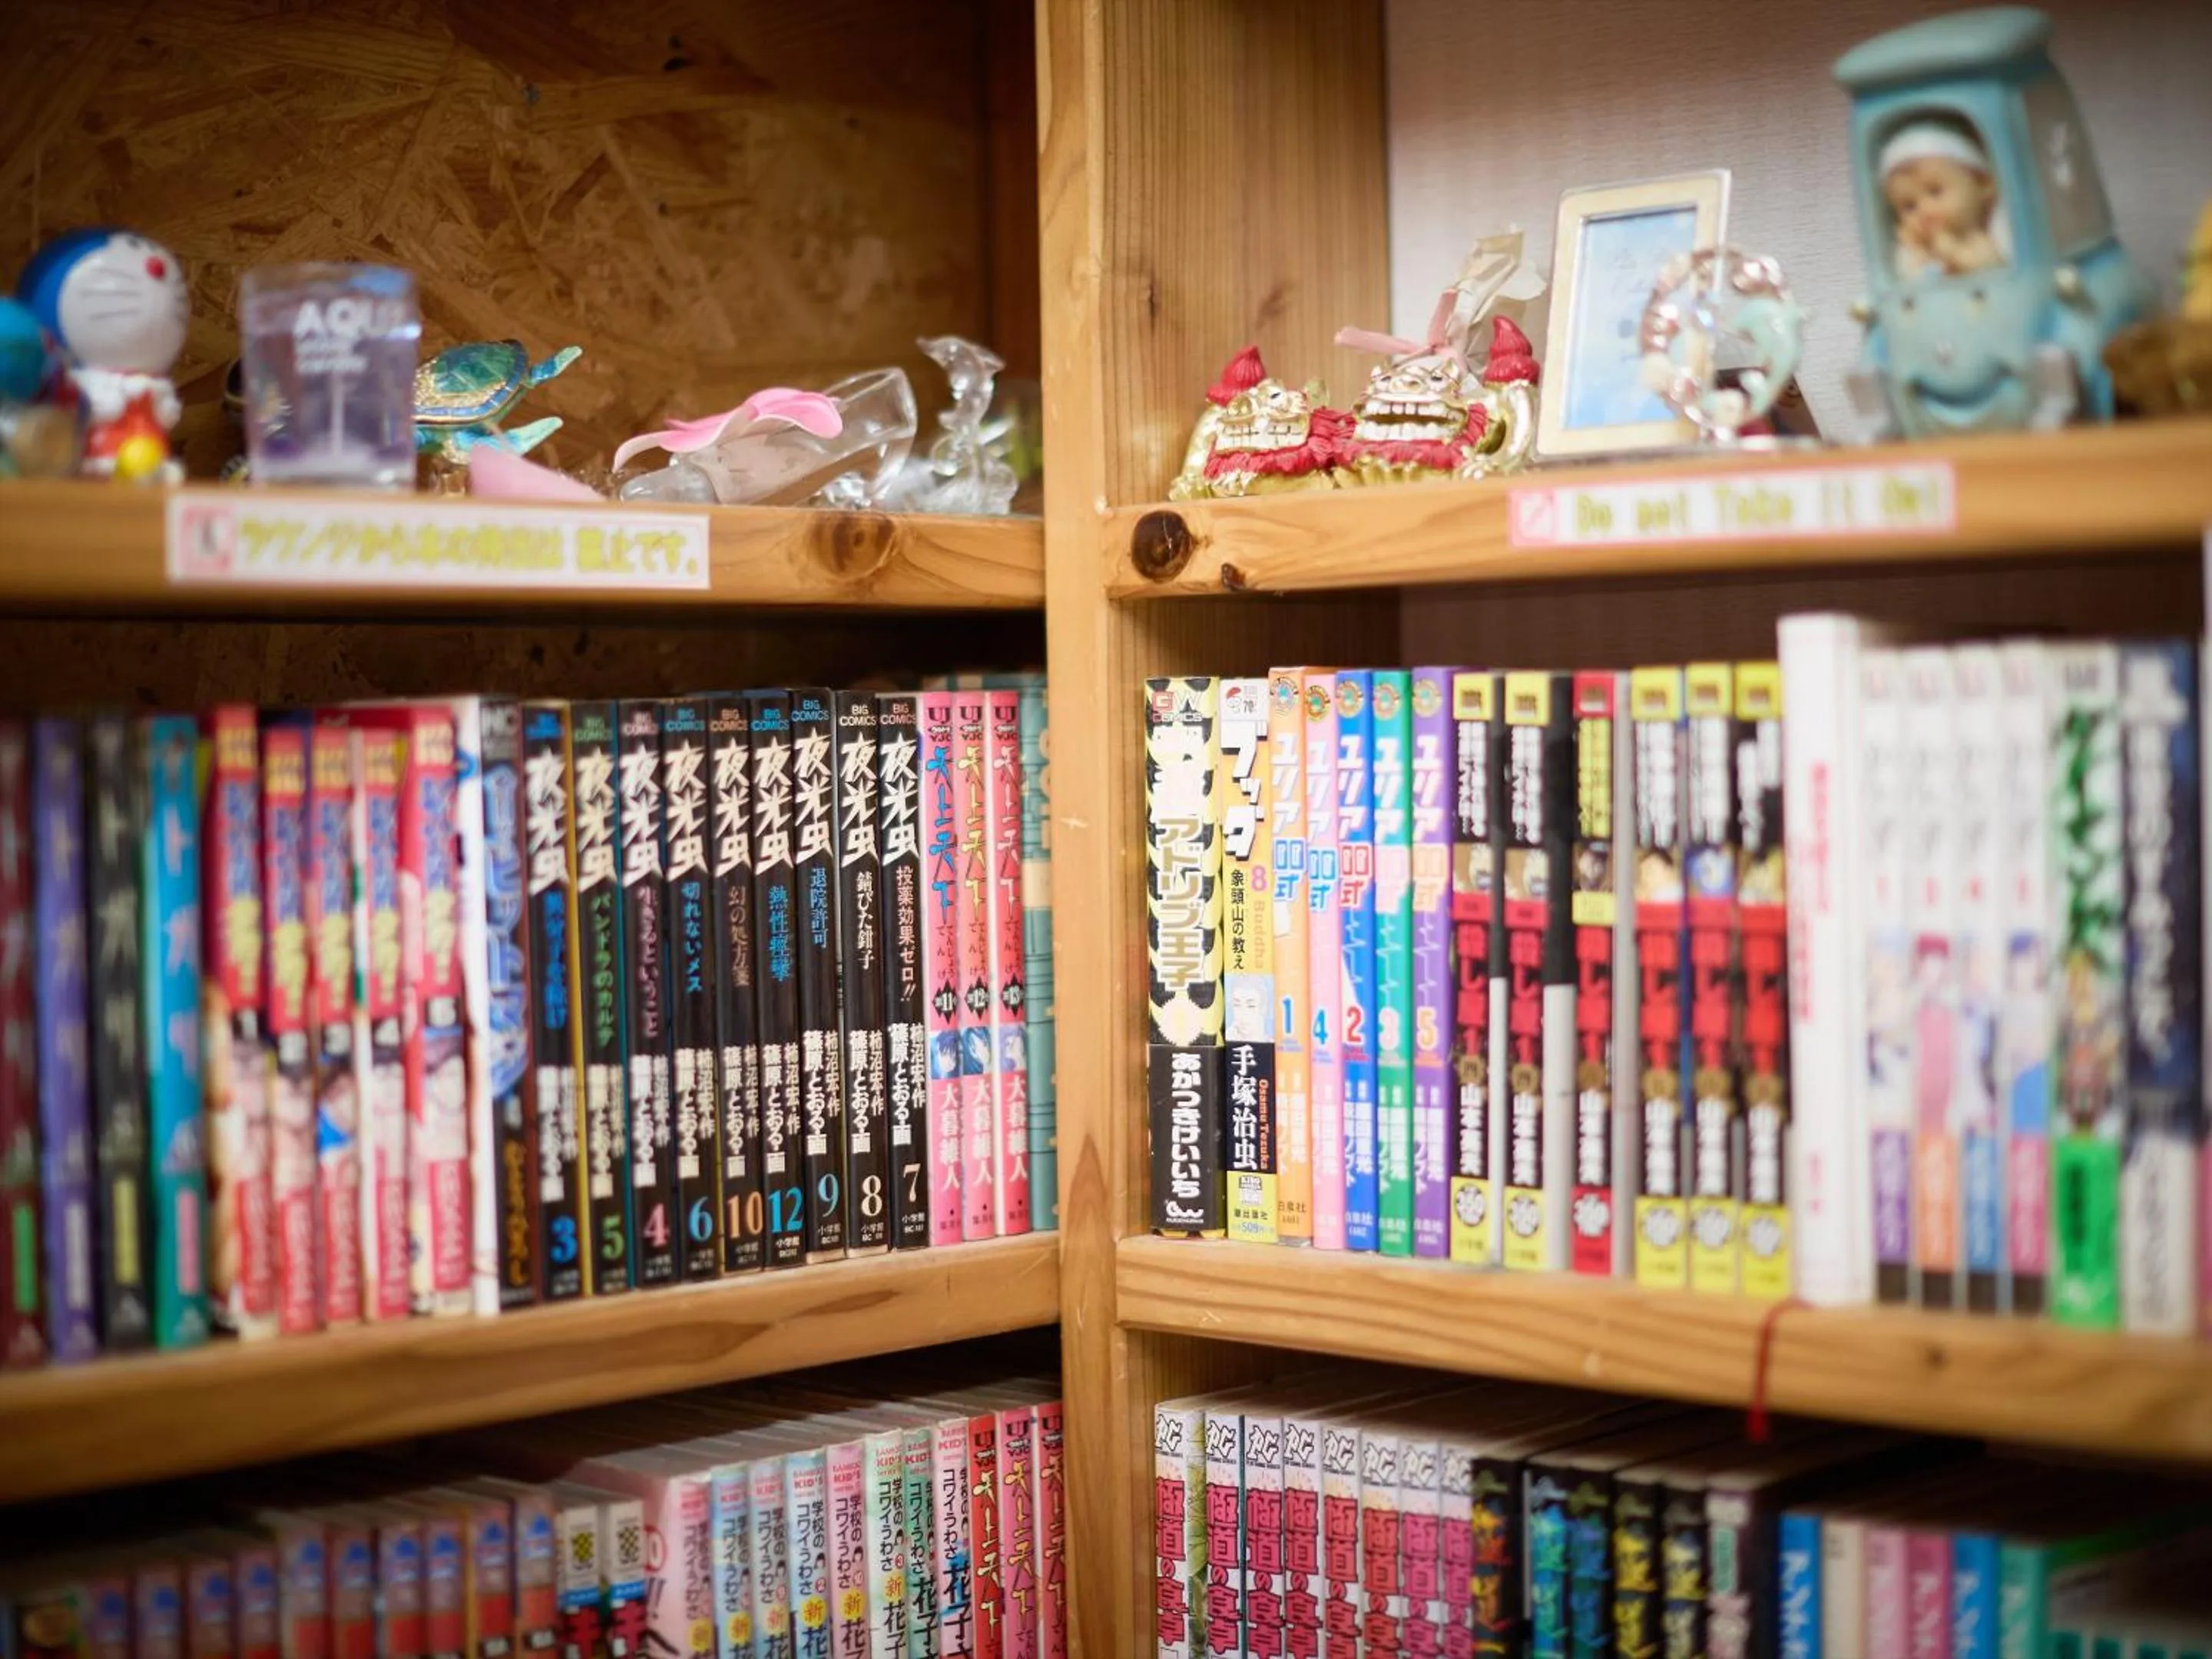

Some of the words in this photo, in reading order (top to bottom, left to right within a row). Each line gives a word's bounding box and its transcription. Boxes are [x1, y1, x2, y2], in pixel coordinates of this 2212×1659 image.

[790, 710, 830, 722] COMICS
[803, 699, 820, 711] BIG
[839, 714, 877, 727] COMICS
[850, 704, 869, 716] BIG
[879, 713, 918, 726] COMICS
[892, 702, 910, 715] BIG
[926, 705, 952, 725] UJ
[958, 705, 982, 725] UJ
[993, 705, 1016, 726] UJ
[664, 738, 709, 882] 夜光虫
[713, 736, 753, 879] 夜光虫
[753, 734, 794, 876] 夜光虫
[793, 727, 834, 865] 夜光虫
[839, 730, 879, 869] 夜光虫
[879, 730, 920, 867] 夜光虫
[1220, 719, 1267, 862] ブッダ
[619, 741, 664, 889] 夜光虫
[1336, 733, 1373, 910] ユリア00式
[1250, 864, 1267, 892] 8
[680, 880, 703, 994] 切れないメス
[1231, 869, 1246, 971] 象頭山の教え
[1282, 997, 1293, 1035] 1
[1312, 1008, 1330, 1045] 4
[1346, 1005, 1363, 1044] 2
[1417, 1008, 1436, 1050] 5
[1231, 1044, 1257, 1171] 手塚治虫
[816, 1173, 839, 1218] 9
[861, 1174, 883, 1218] 8
[902, 1163, 922, 1203] 7
[643, 1202, 670, 1248] 4
[689, 1196, 714, 1243] 6
[727, 1190, 764, 1239] 10
[768, 1186, 804, 1233] 12
[550, 1215, 578, 1263] 3
[601, 1214, 624, 1260] 5
[1207, 1419, 1237, 1458] PC
[1247, 1425, 1280, 1462] PC
[1284, 1425, 1316, 1462] PC
[1323, 1431, 1356, 1469] PC
[1363, 1443, 1398, 1482] PC
[1401, 1445, 1437, 1485] PC
[812, 1499, 826, 1550] 学校の
[849, 1493, 863, 1542] 学校の
[878, 1480, 893, 1572] コワイうわさ
[909, 1482, 925, 1575] コワイうわさ
[942, 1468, 958, 1559] コワイうわさ
[796, 1504, 813, 1596] コワイうわさ
[836, 1497, 850, 1590] コワイうわさ
[1206, 1482, 1243, 1654] 極道の食卓
[1363, 1507, 1402, 1659] 極道の食
